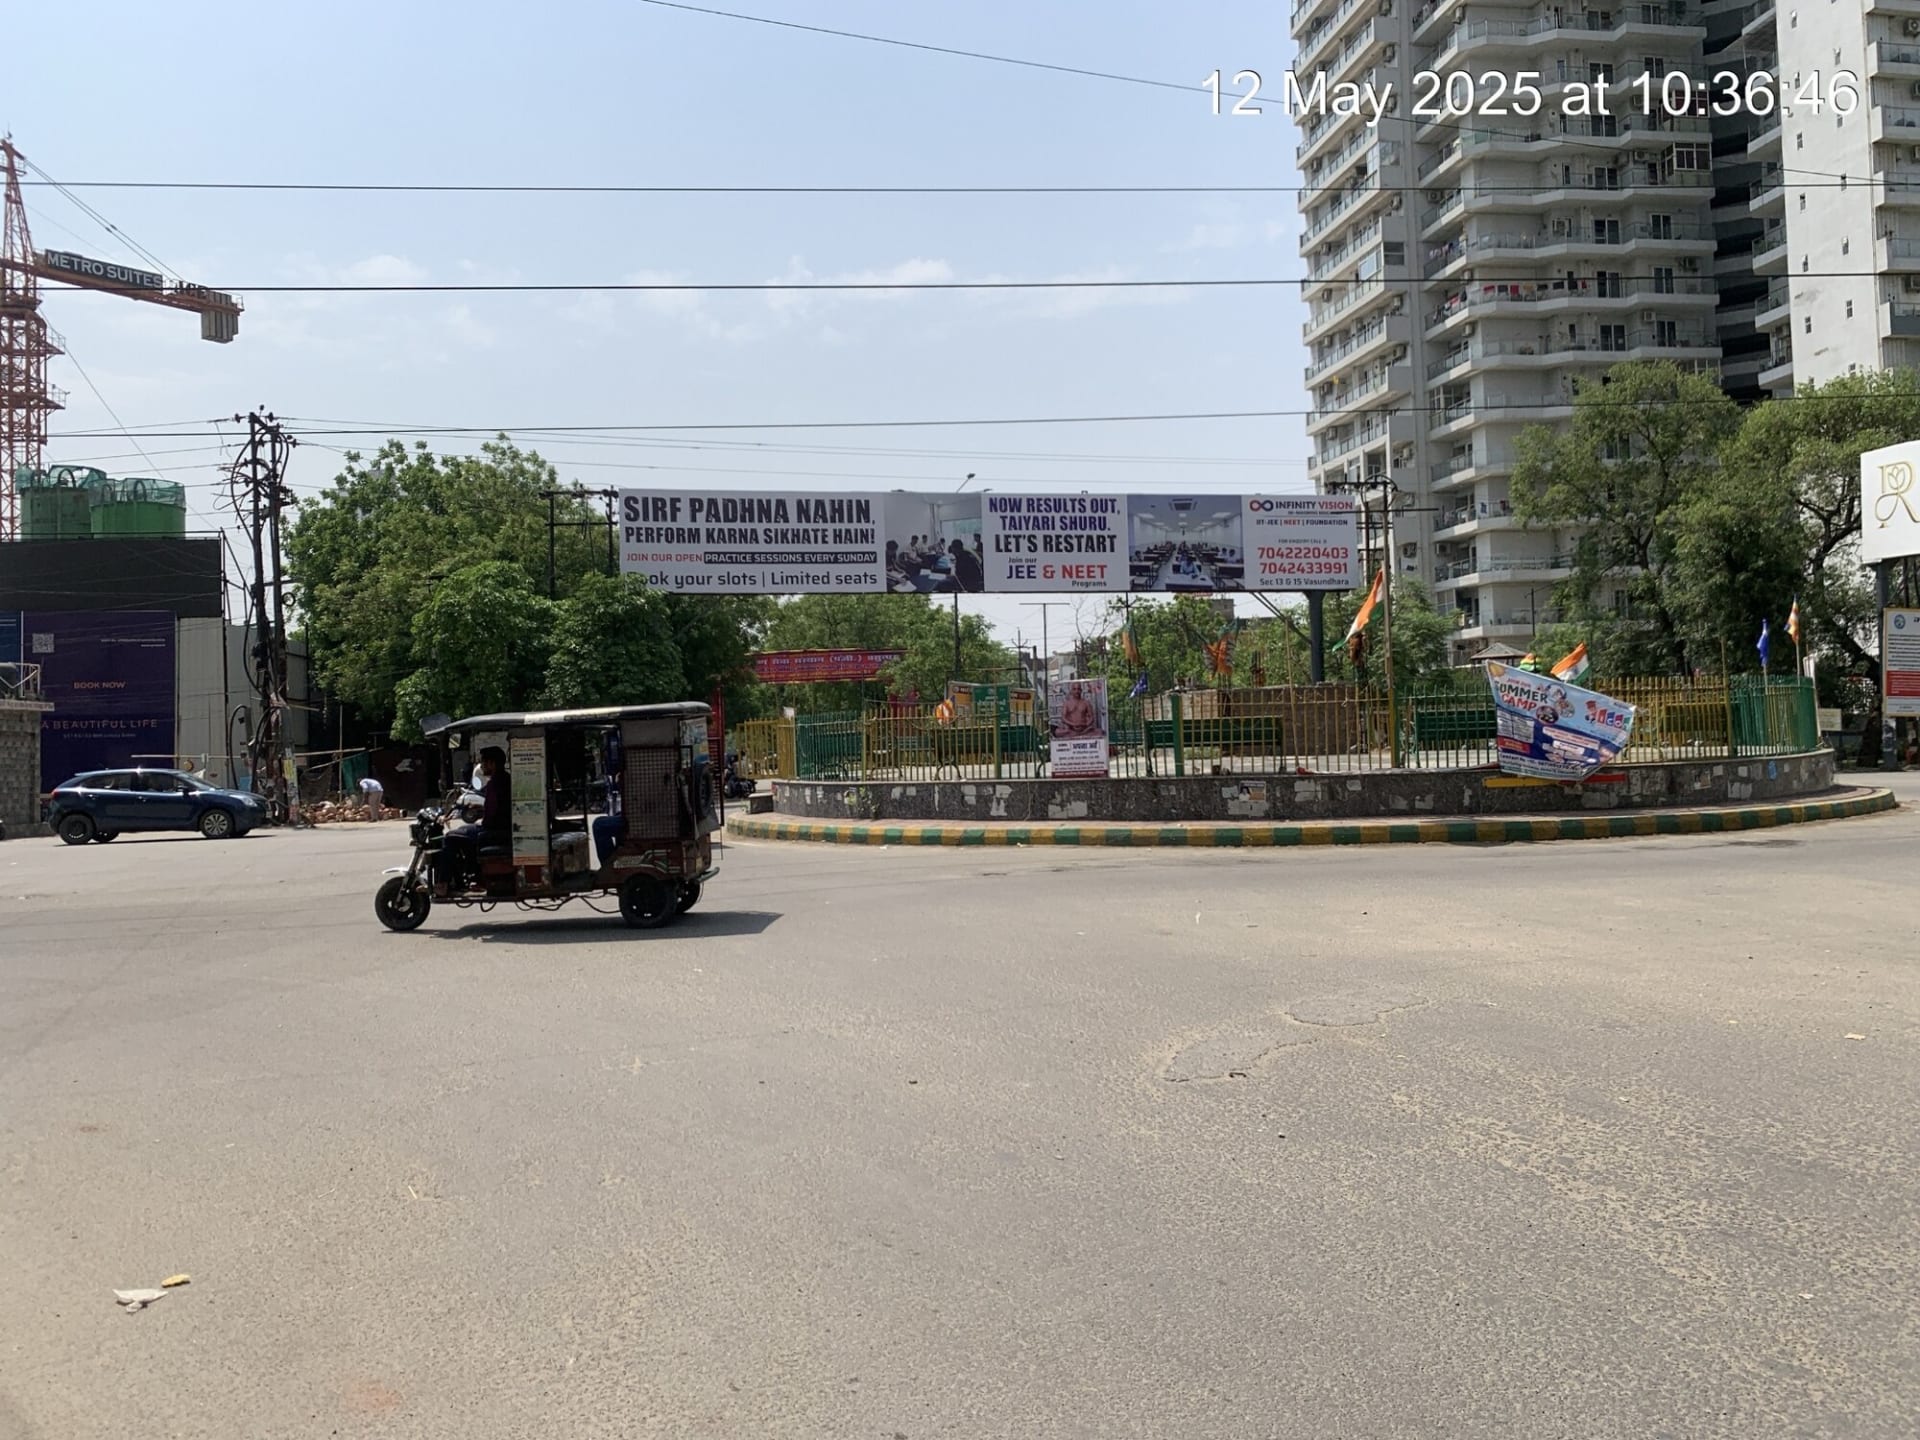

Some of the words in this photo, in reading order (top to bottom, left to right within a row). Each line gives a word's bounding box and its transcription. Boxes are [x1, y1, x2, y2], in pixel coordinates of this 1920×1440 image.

[47, 252, 104, 275] METRO
[106, 266, 163, 289] SUITES
[624, 495, 682, 523] SIRF
[688, 497, 790, 524] PADHNA
[988, 497, 1023, 513] NOW
[1026, 498, 1086, 513] RESULTS
[1275, 501, 1316, 510] INFINITY
[1318, 501, 1353, 510] VISION
[1000, 515, 1056, 531] TAIYARI
[1059, 515, 1111, 531] SHURU.
[625, 527, 700, 544] PERFORM
[706, 527, 760, 544] KARNA
[763, 528, 829, 545] SIKHATE
[833, 528, 876, 545] HAIN!
[1043, 534, 1117, 553] RESTART
[626, 553, 648, 562] JOIN
[651, 553, 672, 562] OUR
[675, 553, 702, 562] OPEN
[705, 553, 751, 563] PRACTICE
[754, 553, 802, 563] SESSIONS
[804, 553, 836, 563] EVERY
[838, 553, 876, 563] SUNDAY
[1257, 547, 1349, 559] 7042220403
[1006, 564, 1037, 579] JEE
[1042, 565, 1056, 579] &
[1061, 564, 1108, 579] NEET
[1259, 562, 1348, 574] 7042433991
[674, 574, 713, 589] your
[717, 571, 757, 586] slots
[771, 571, 830, 586] Limited
[835, 572, 878, 586] seats
[1071, 580, 1108, 589] Programs
[1259, 577, 1273, 586] Sec
[1275, 577, 1283, 586] 13
[1294, 577, 1302, 586] 15
[1303, 577, 1349, 586] Vasundhara
[102, 681, 126, 689] NOW
[1501, 693, 1537, 711] CAMP
[53, 720, 127, 730] BEAUTIFUL
[130, 719, 158, 728] LIFE
